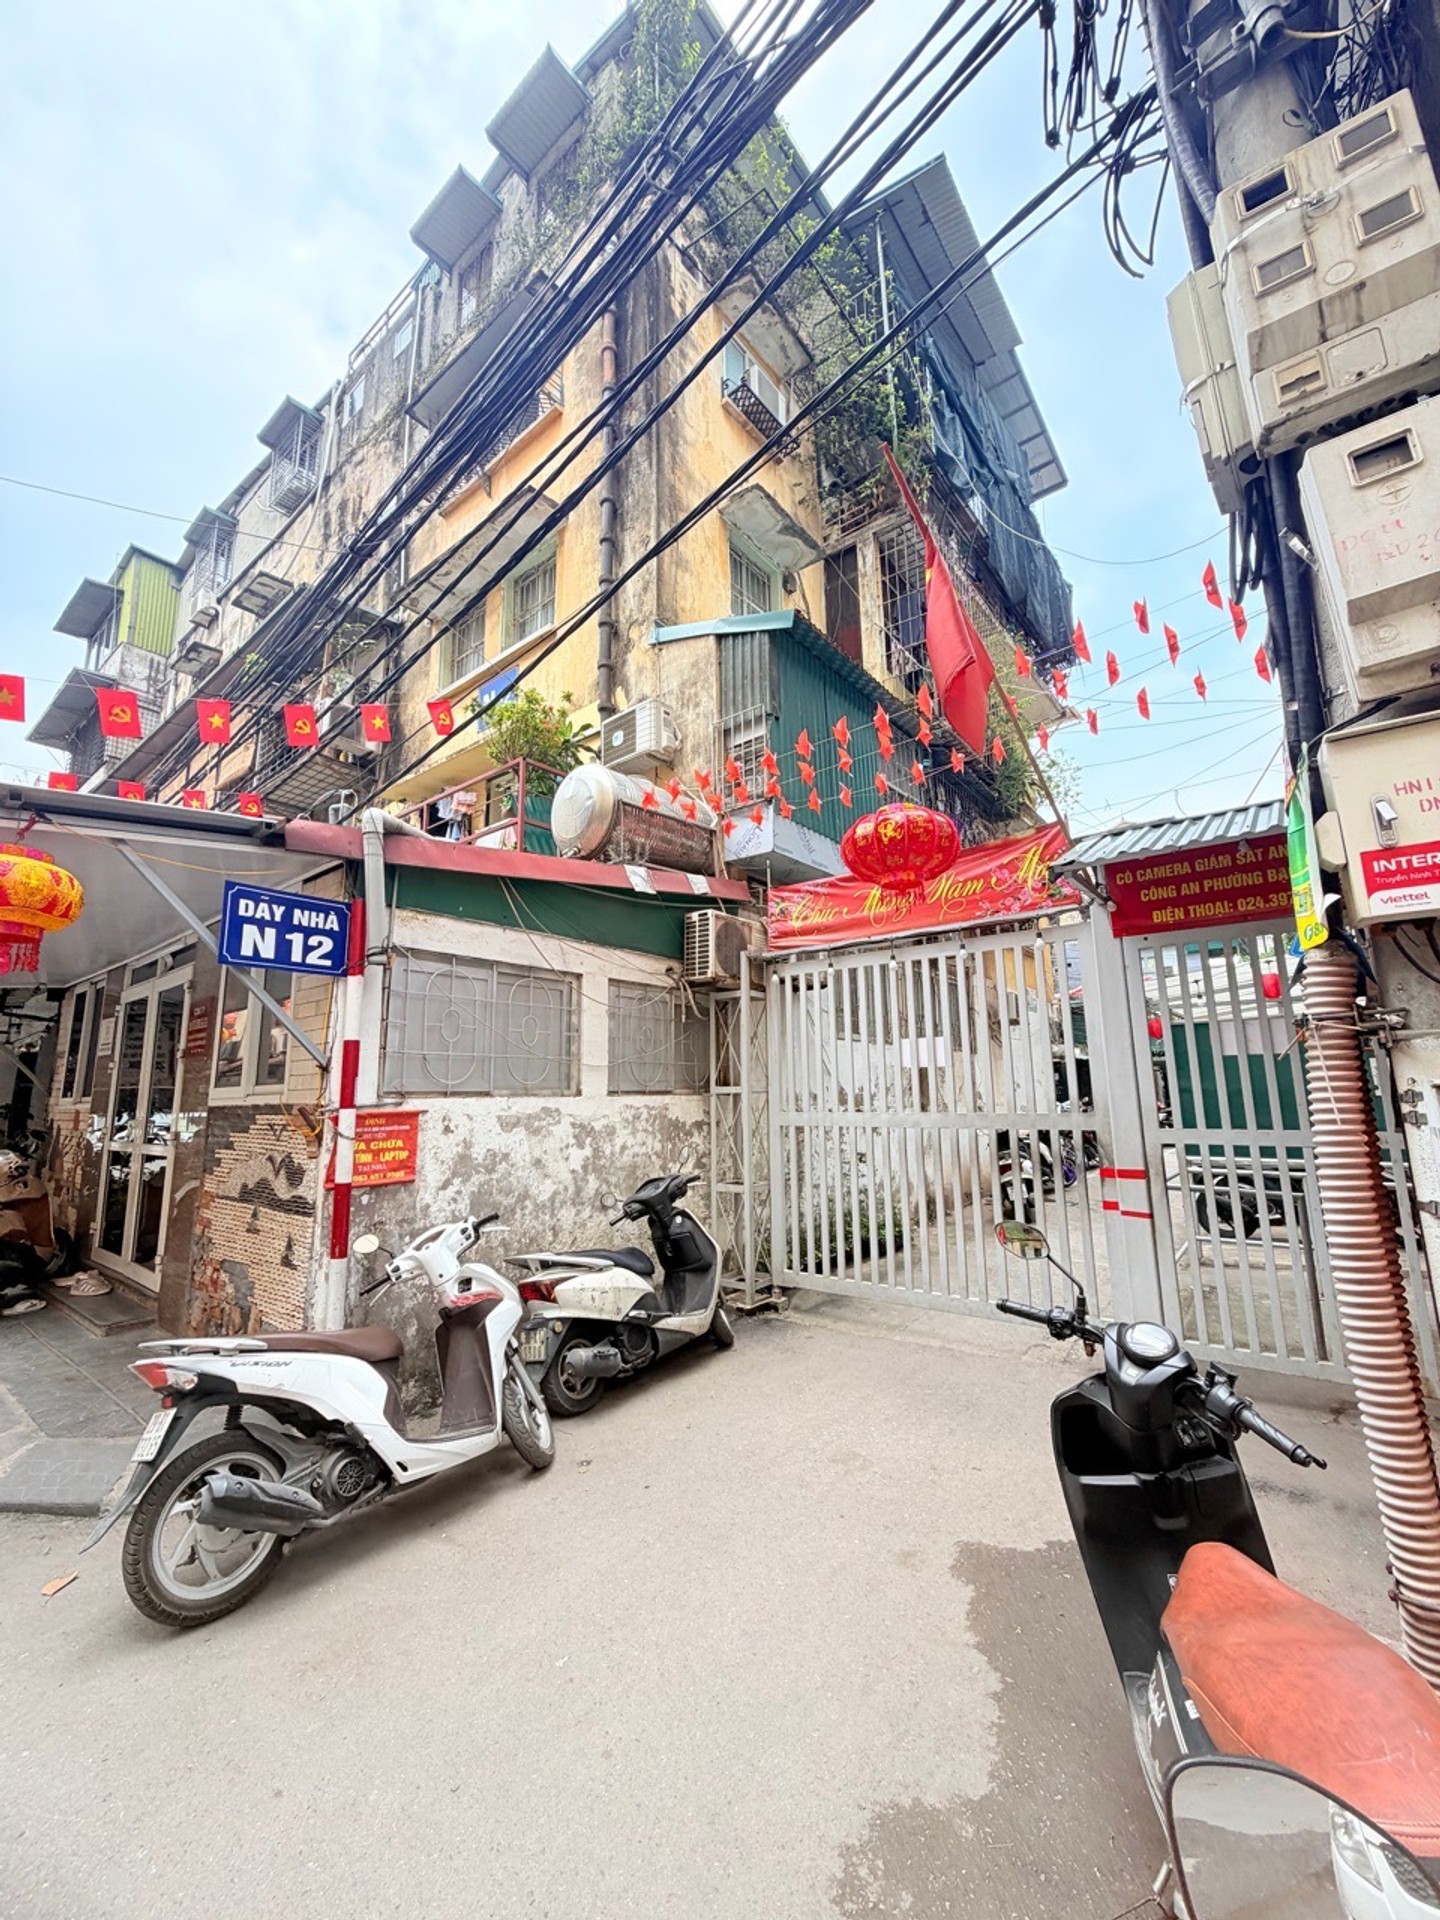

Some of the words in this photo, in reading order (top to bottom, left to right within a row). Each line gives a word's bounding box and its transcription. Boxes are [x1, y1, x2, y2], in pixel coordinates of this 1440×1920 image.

[1116, 870, 1133, 885] CÓ
[1136, 861, 1192, 882] CAMERA
[1195, 854, 1232, 872] GIÁM
[1373, 852, 1440, 873] INTER
[1141, 886, 1177, 902] CÔNG
[1181, 881, 1201, 896] AN
[1204, 871, 1264, 893] PHƯỜNG
[1380, 891, 1430, 904] viettel
[238, 895, 286, 922] DÃY
[292, 908, 340, 932] NHÀ
[776, 894, 839, 936] Chúc
[924, 870, 985, 921] Năm
[1152, 906, 1185, 924] ĐIỆN
[1188, 900, 1234, 918] THOẠI:
[240, 923, 277, 960] N
[285, 931, 334, 967] 12
[370, 1139, 404, 1150] CHỮA
[380, 1150, 409, 1162] LAPTOP
